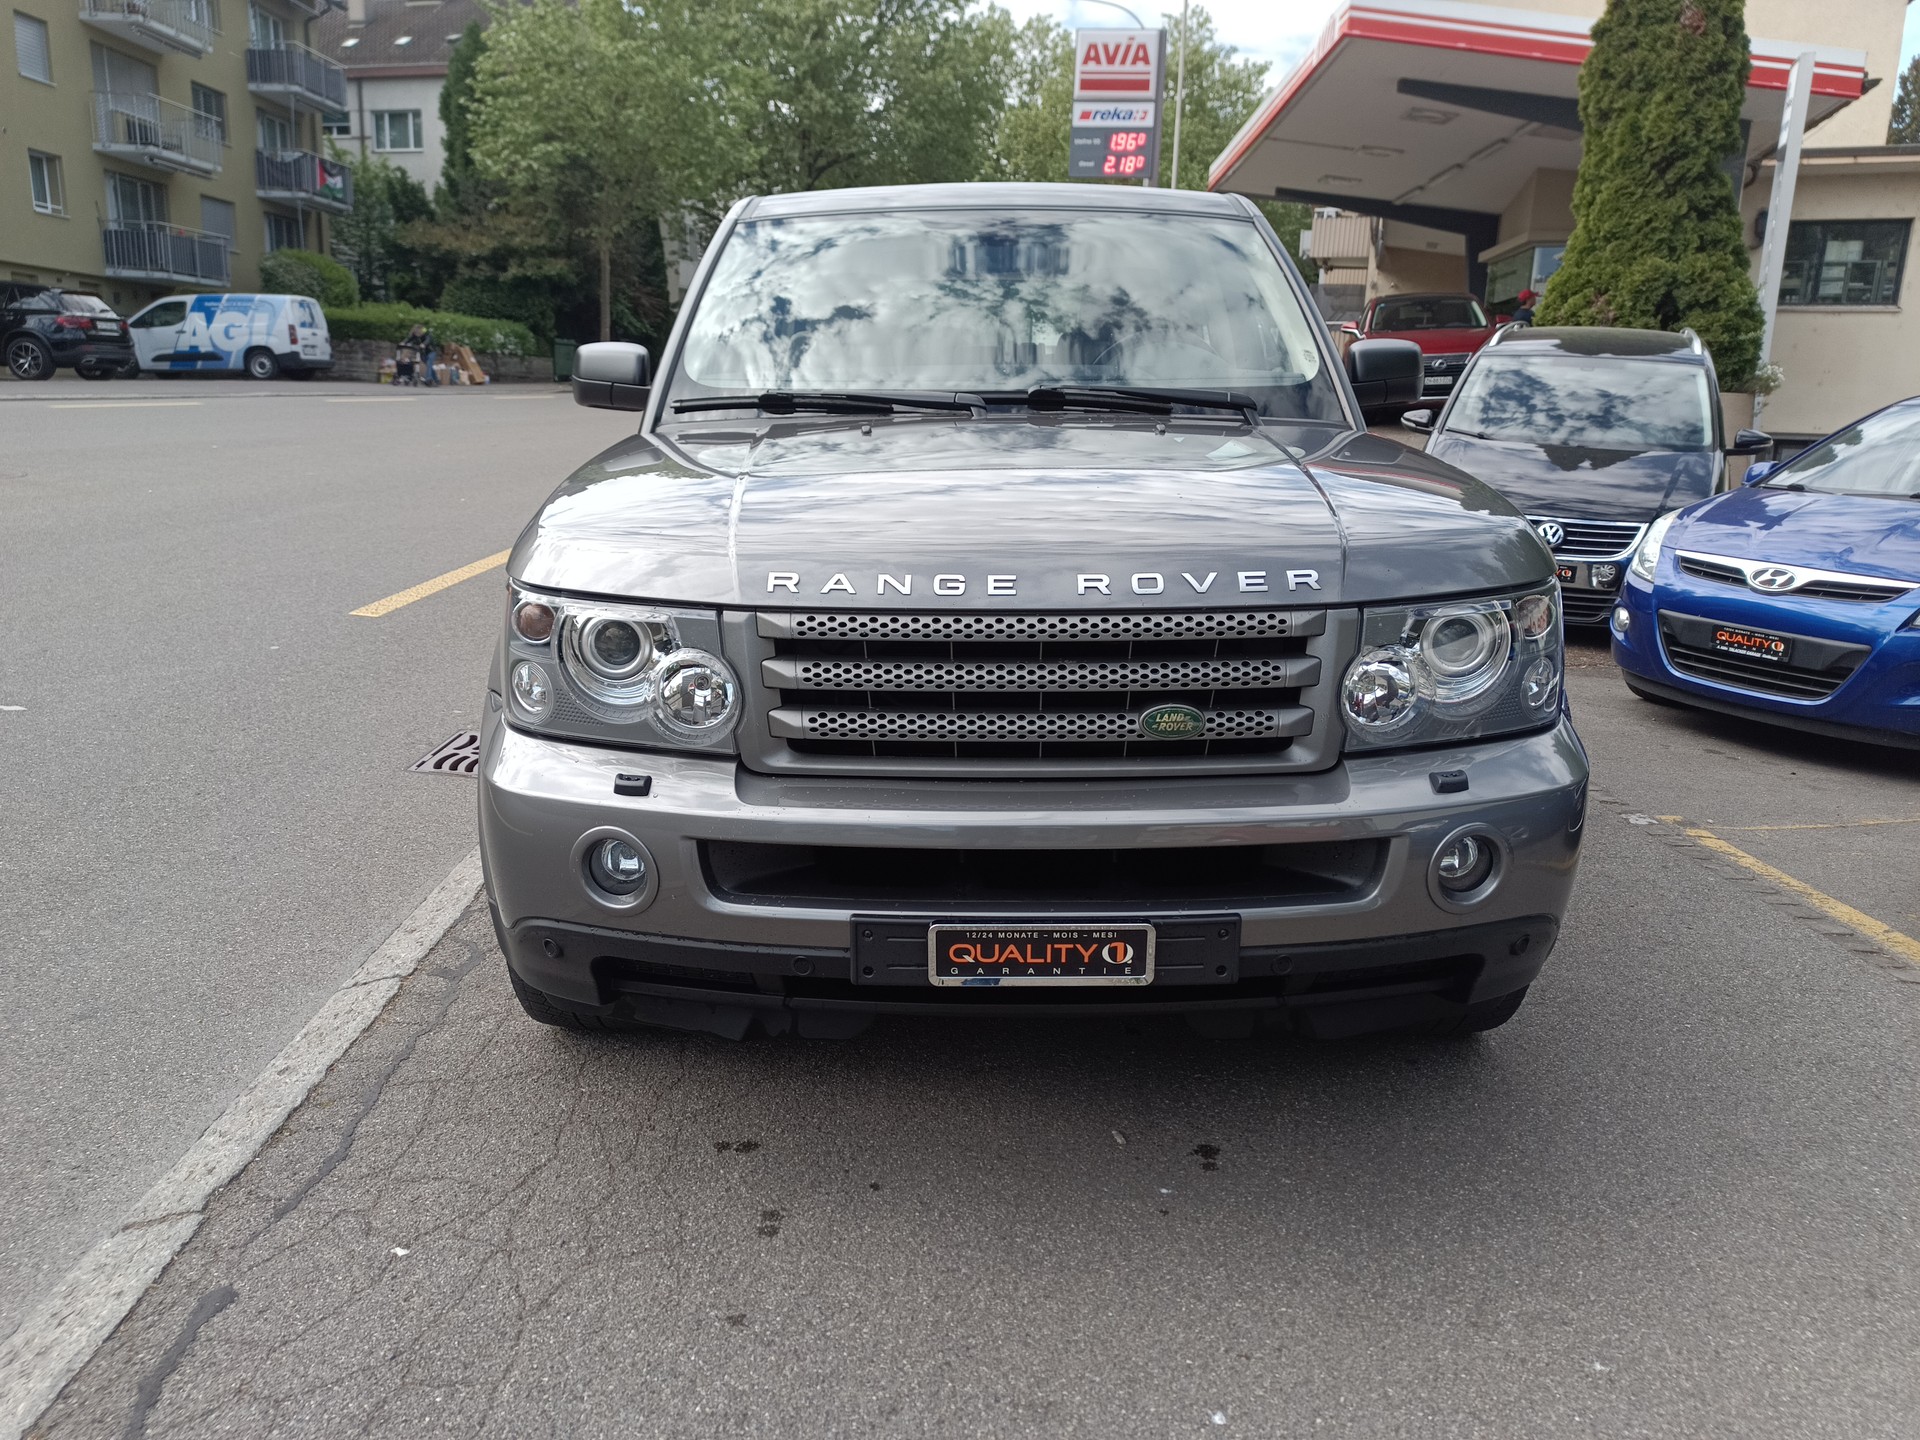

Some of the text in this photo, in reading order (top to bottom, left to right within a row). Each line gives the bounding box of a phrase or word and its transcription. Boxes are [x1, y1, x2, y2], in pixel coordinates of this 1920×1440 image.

[766, 569, 1322, 596] RANGE ROVER
[1716, 631, 1771, 648] QUALITY
[1155, 713, 1185, 722] LAND
[1158, 722, 1193, 731] ROVER
[948, 943, 1099, 963] QUALITY
[950, 967, 1132, 975] GARANTIE
